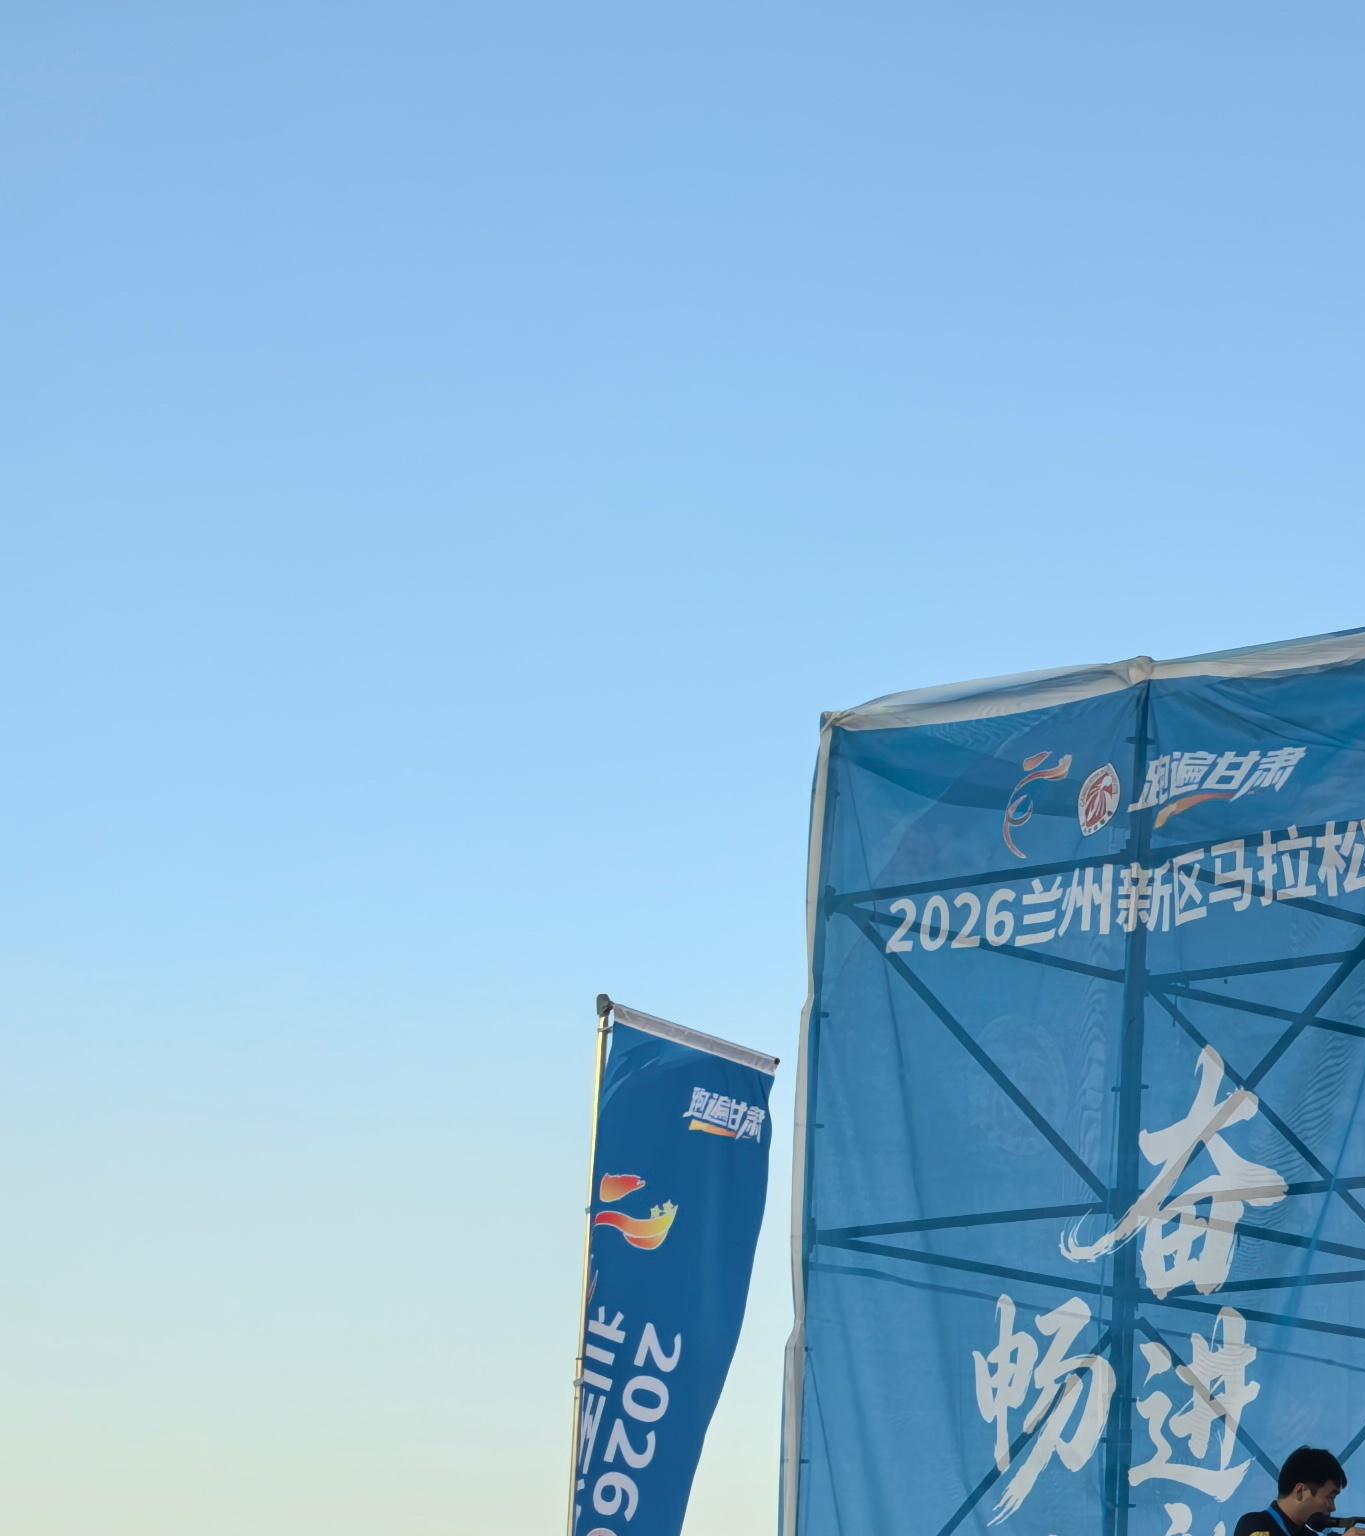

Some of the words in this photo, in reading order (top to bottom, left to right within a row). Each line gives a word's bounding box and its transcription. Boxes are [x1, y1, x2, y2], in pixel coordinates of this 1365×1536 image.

[1128, 746, 1307, 813] 跑遍甘肃
[683, 1086, 766, 1145] 跑遍甘肃
[593, 1321, 682, 1522] 2026
